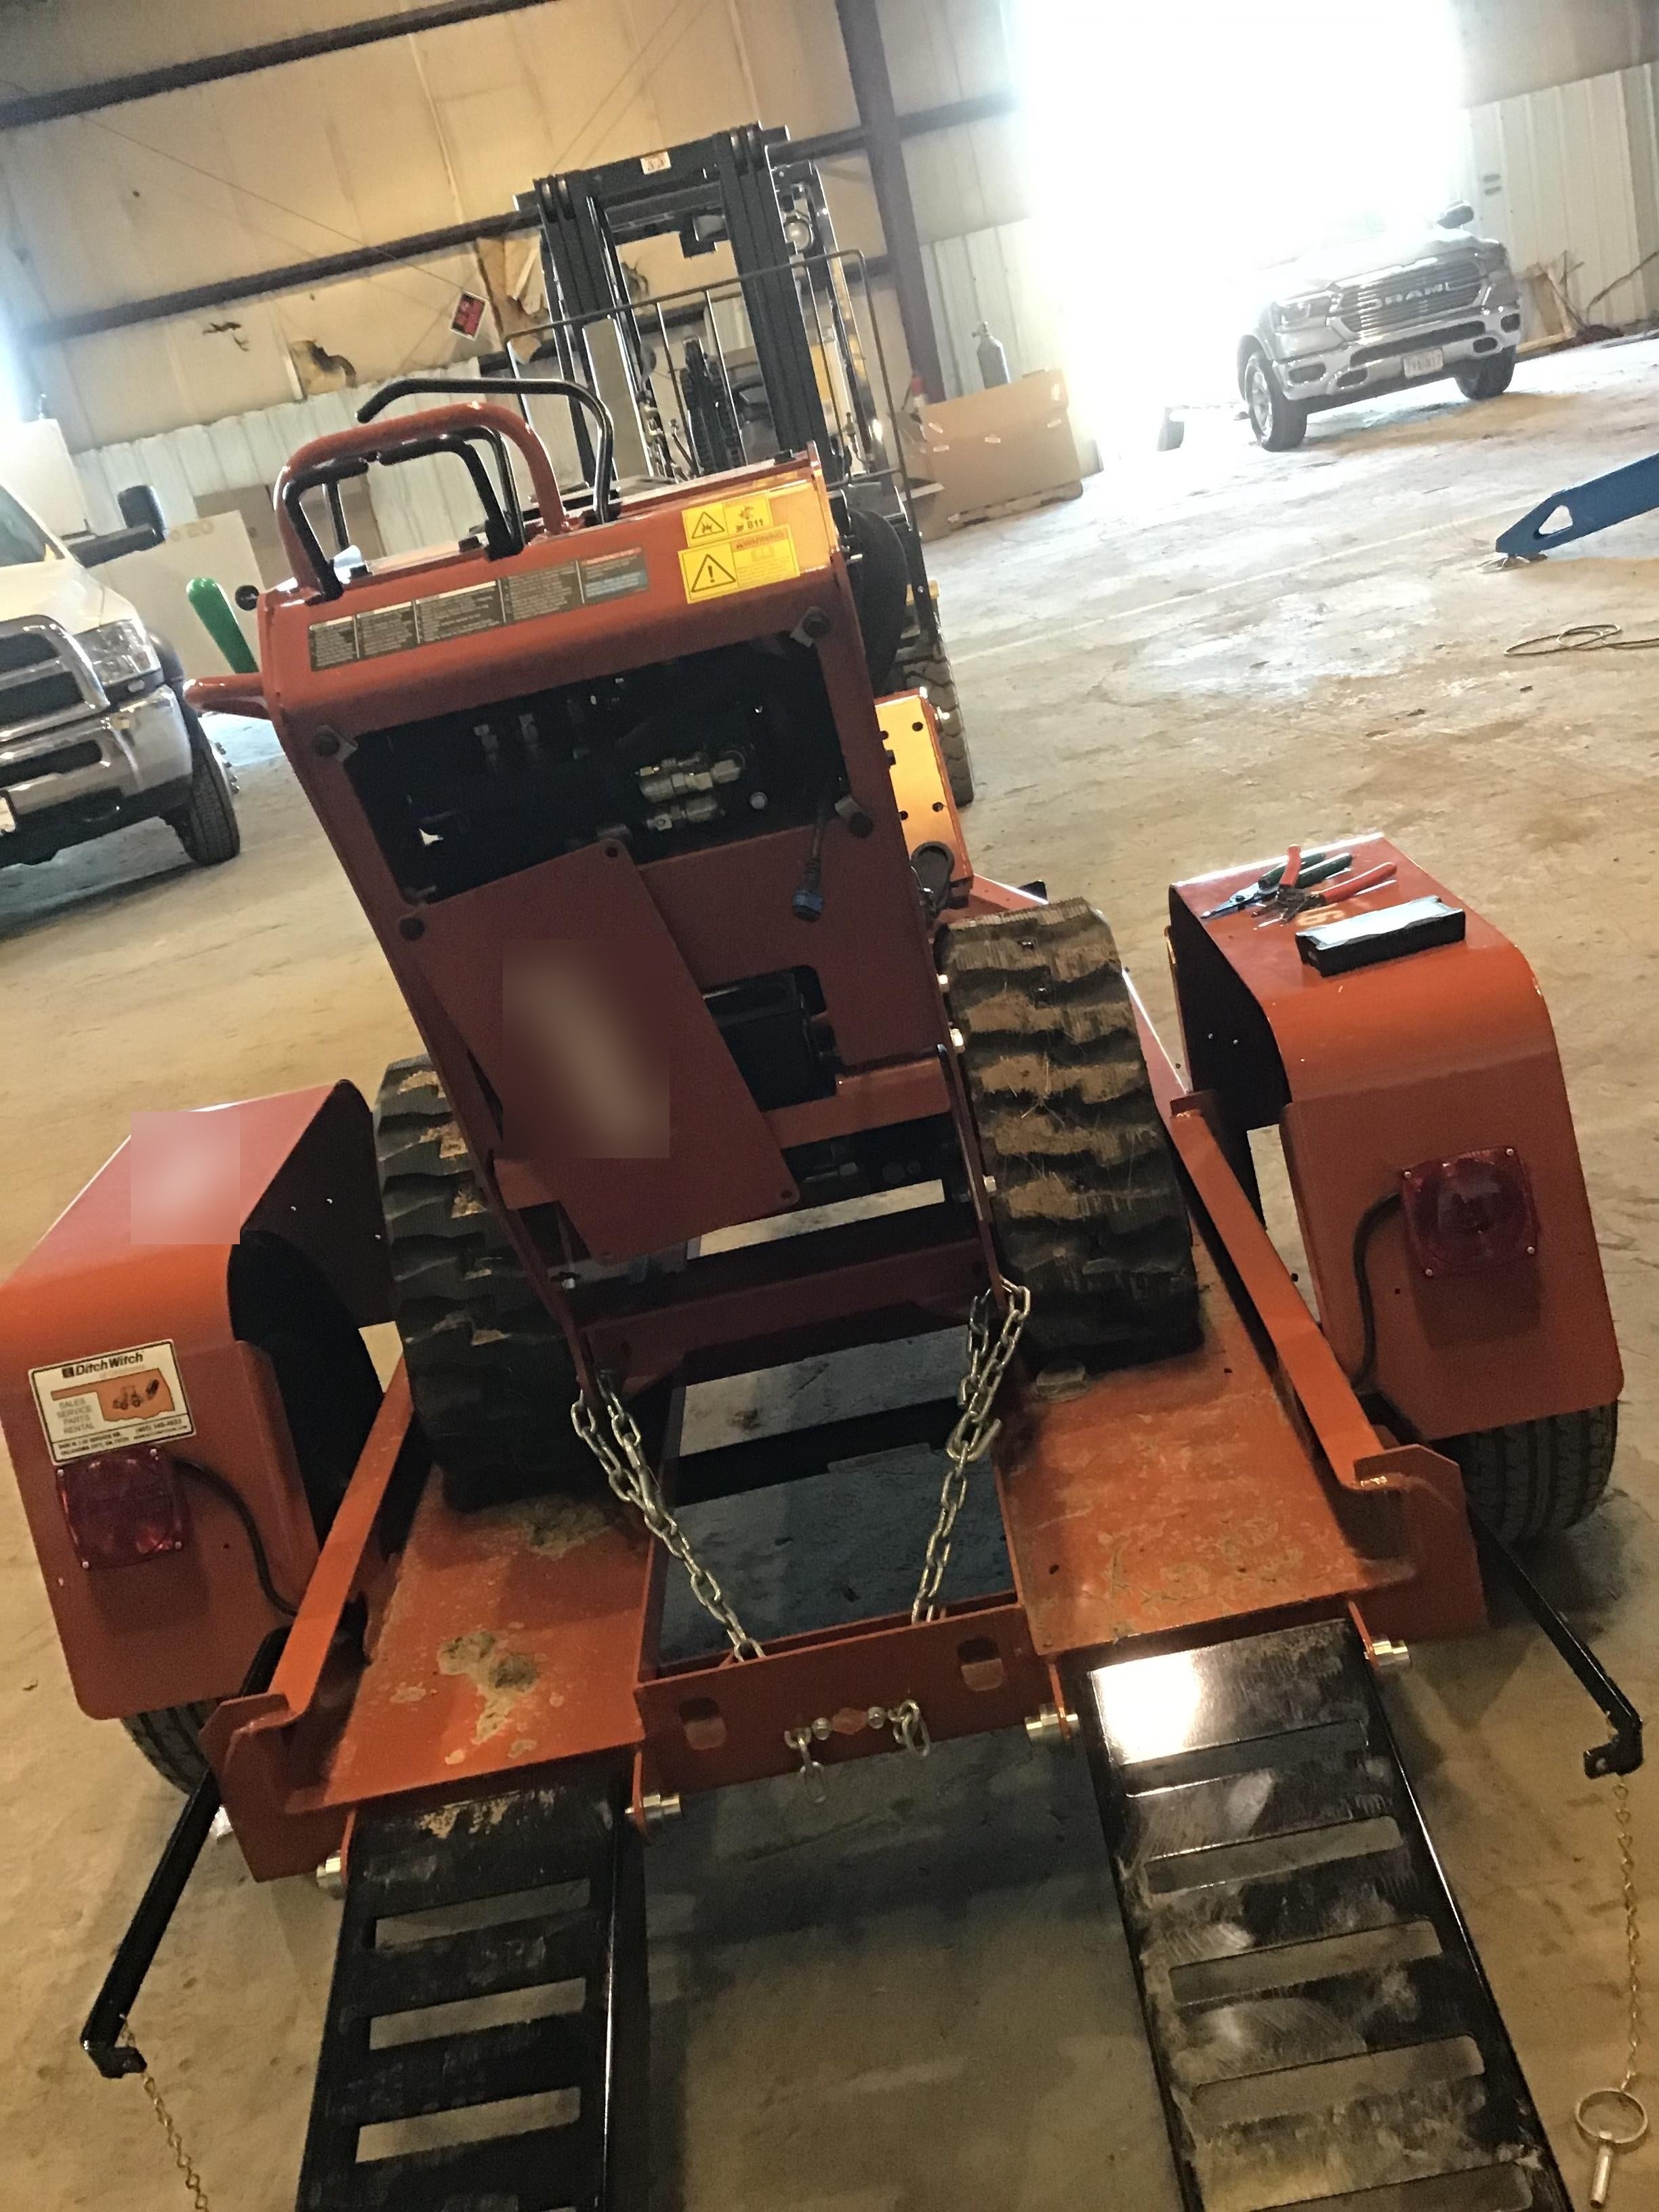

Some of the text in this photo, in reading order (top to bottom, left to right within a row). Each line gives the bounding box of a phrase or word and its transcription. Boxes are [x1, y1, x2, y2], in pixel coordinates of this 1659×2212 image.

[1385, 283, 1443, 304] RAM
[747, 518, 764, 529] 811
[75, 1359, 108, 1376] Ditch
[108, 1352, 144, 1368] Witch
